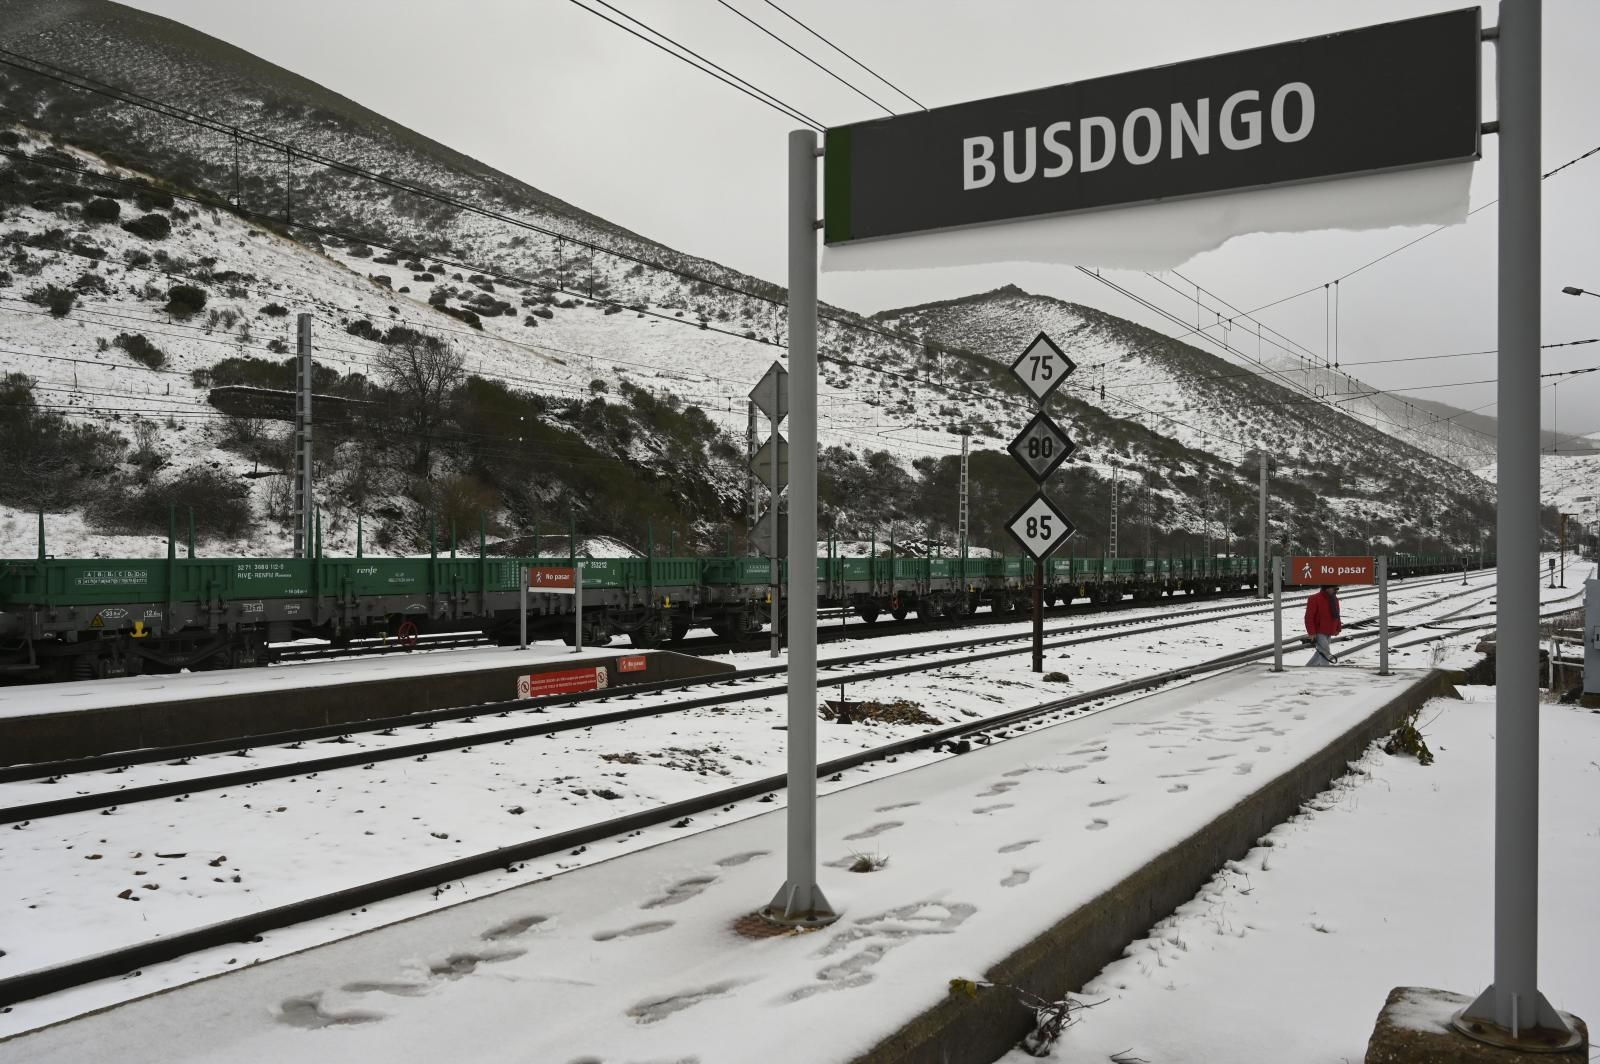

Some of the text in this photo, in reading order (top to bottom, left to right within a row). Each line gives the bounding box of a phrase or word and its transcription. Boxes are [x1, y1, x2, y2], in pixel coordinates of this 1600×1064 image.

[963, 81, 1315, 191] BUSDONGO
[1029, 355, 1054, 381] 75
[1028, 436, 1053, 459] 80
[1026, 515, 1052, 540] 85
[356, 565, 378, 576] renfe
[1321, 565, 1366, 576] No pasar
